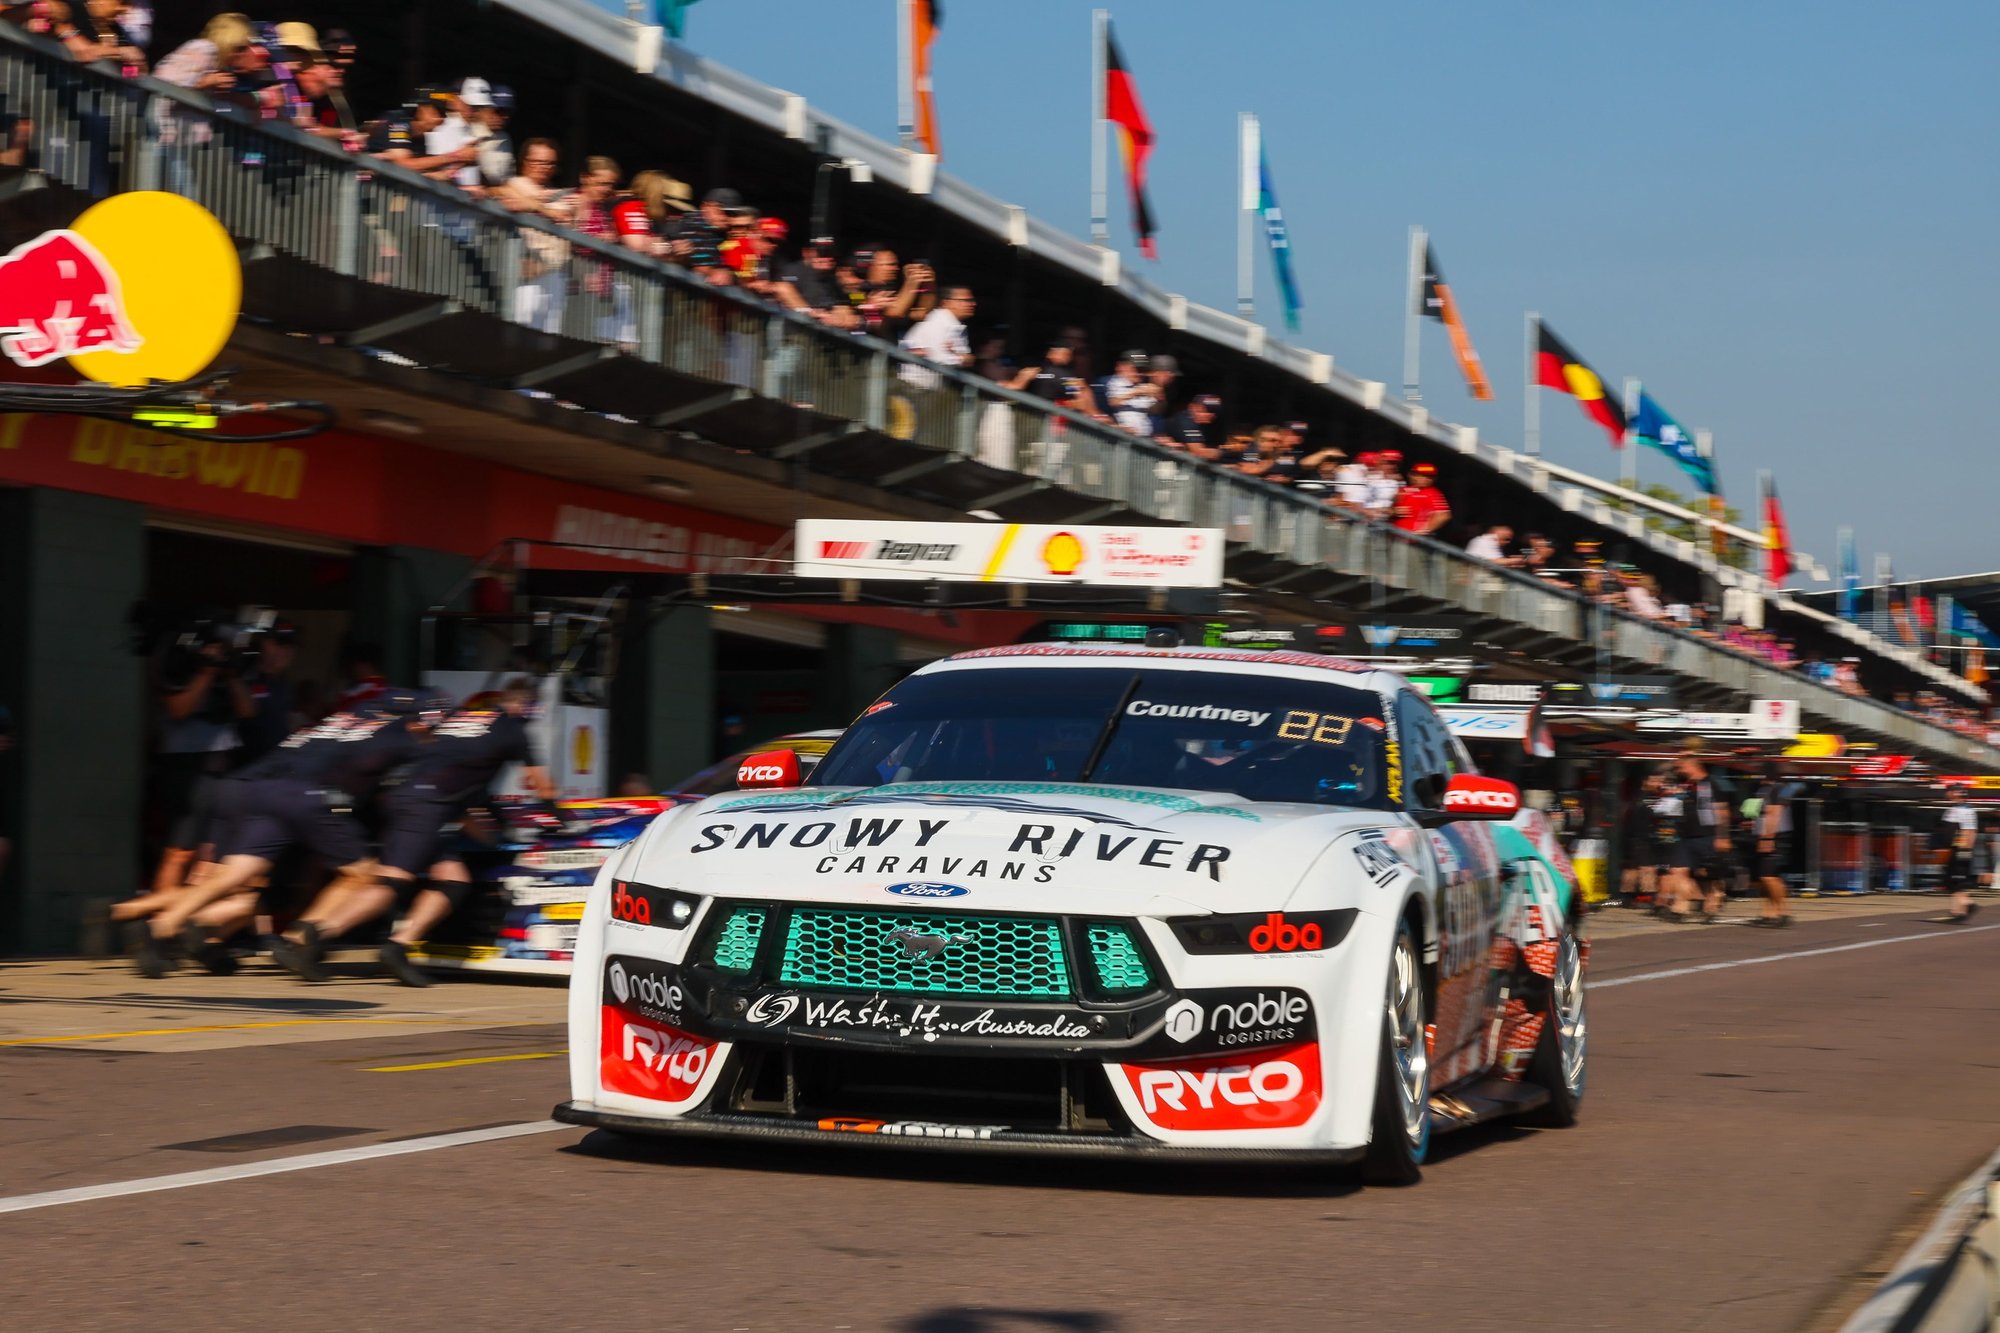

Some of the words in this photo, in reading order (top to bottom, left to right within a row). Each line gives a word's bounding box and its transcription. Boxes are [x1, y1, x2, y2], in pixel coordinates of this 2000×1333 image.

[1126, 700, 1271, 727] Courtney
[1277, 710, 1354, 744] 22
[738, 765, 784, 781] RYCO
[1443, 790, 1517, 808] RYCO
[691, 817, 950, 854] SNOWY
[1007, 823, 1231, 882] RIVER
[816, 855, 1055, 883] CARAVANS
[612, 882, 650, 925] dba
[899, 883, 957, 898] Ford
[1249, 913, 1322, 952] dba
[630, 972, 682, 1011] noble
[1210, 991, 1308, 1031] noble
[960, 1009, 1091, 1037] Australia
[1218, 1027, 1295, 1045] LOGISTICS
[623, 1023, 707, 1084] RYCO
[1139, 1061, 1304, 1113] RYCO
